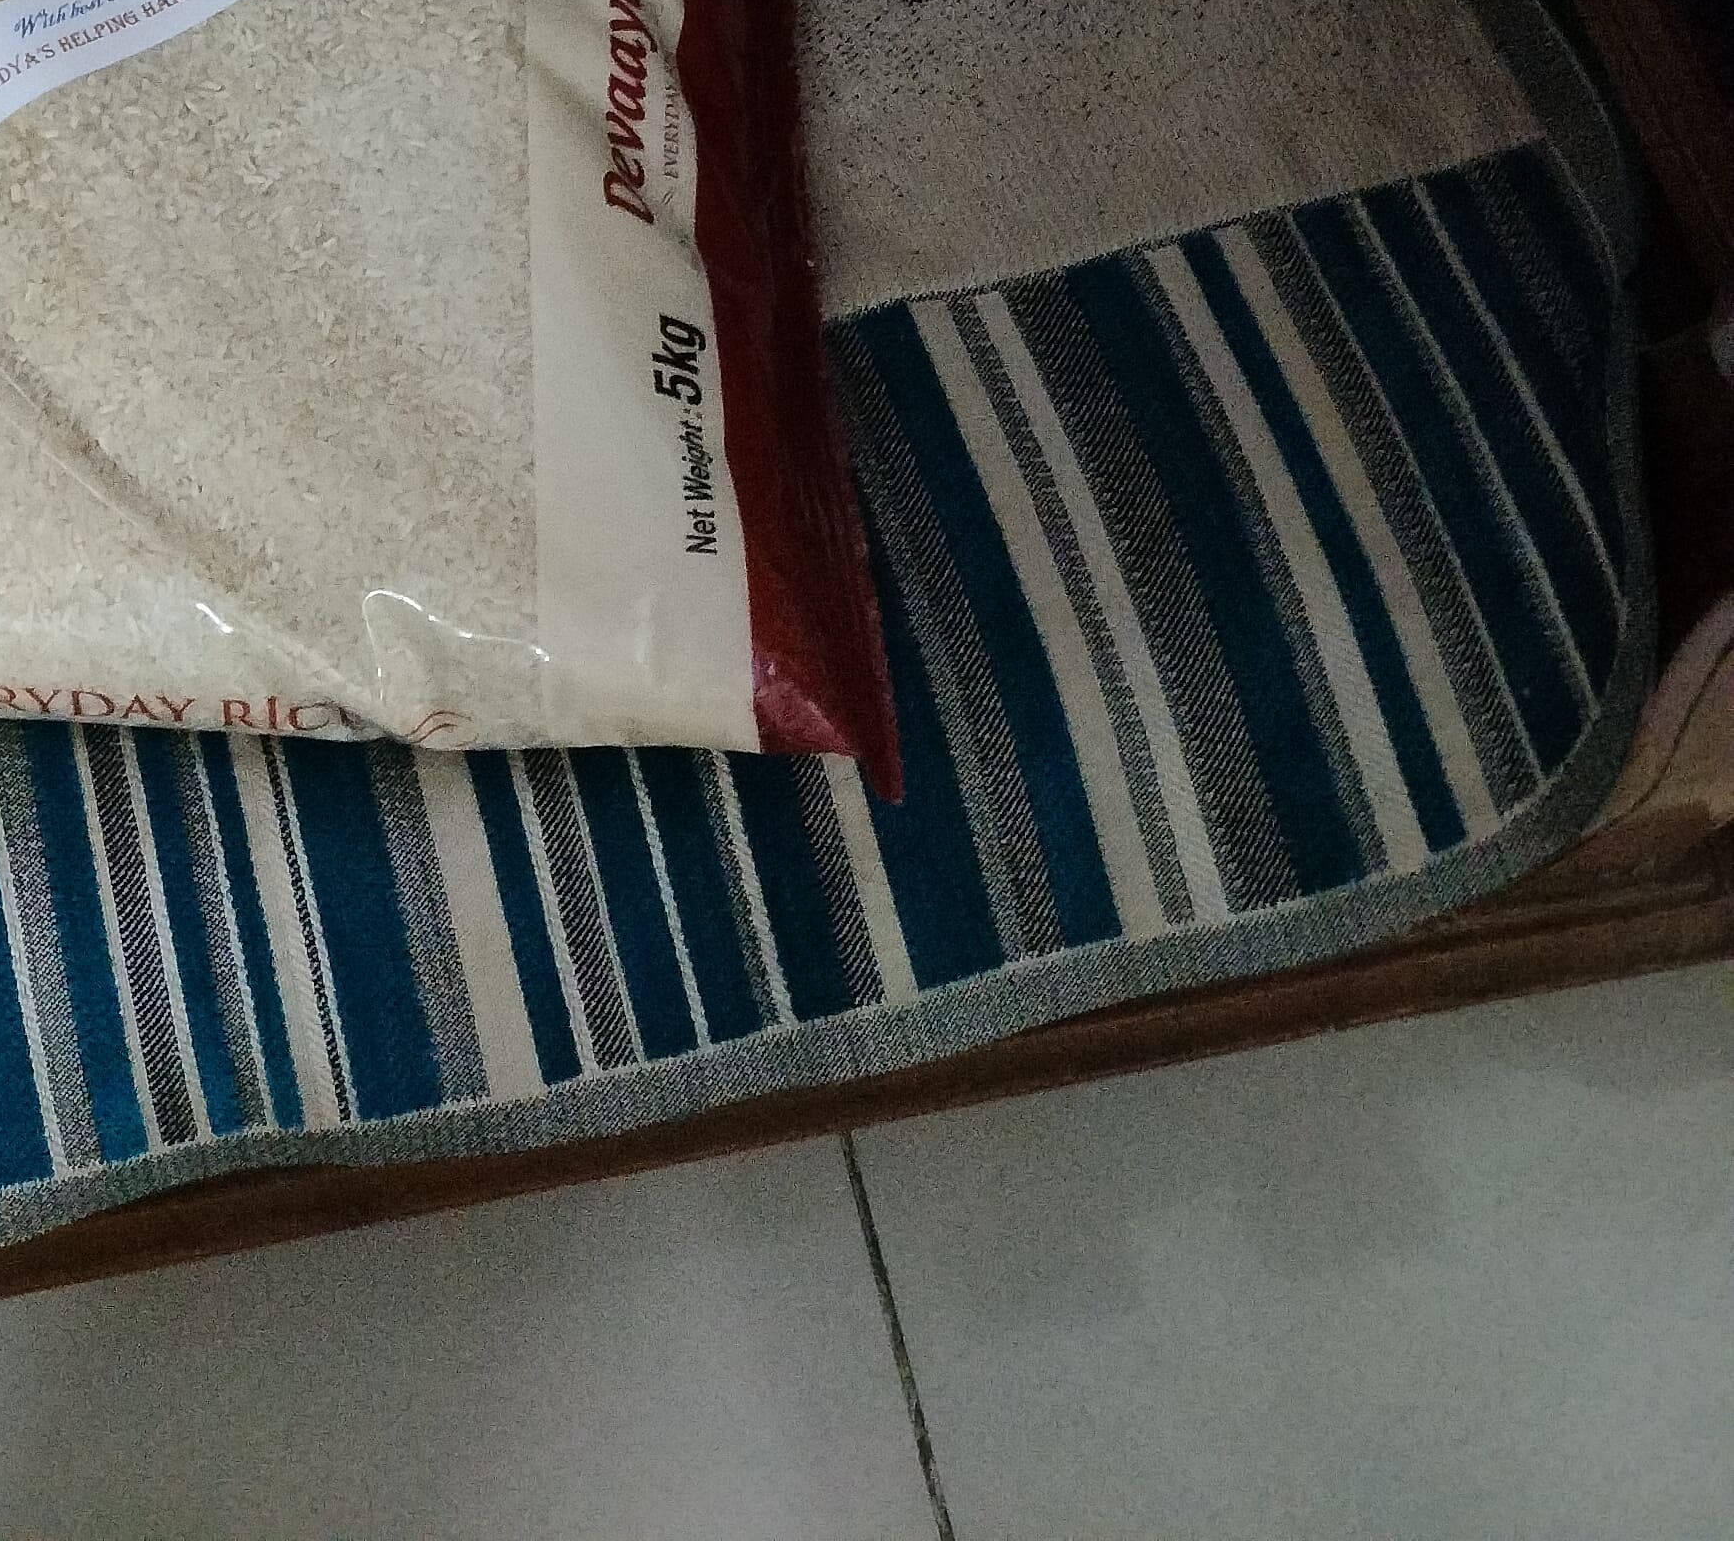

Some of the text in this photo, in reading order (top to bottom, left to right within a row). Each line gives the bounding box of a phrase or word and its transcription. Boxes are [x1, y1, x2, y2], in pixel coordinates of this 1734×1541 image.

[14, 4, 68, 39] With
[59, 10, 139, 53] HELPING
[652, 314, 718, 555] Net Weight 5kg
